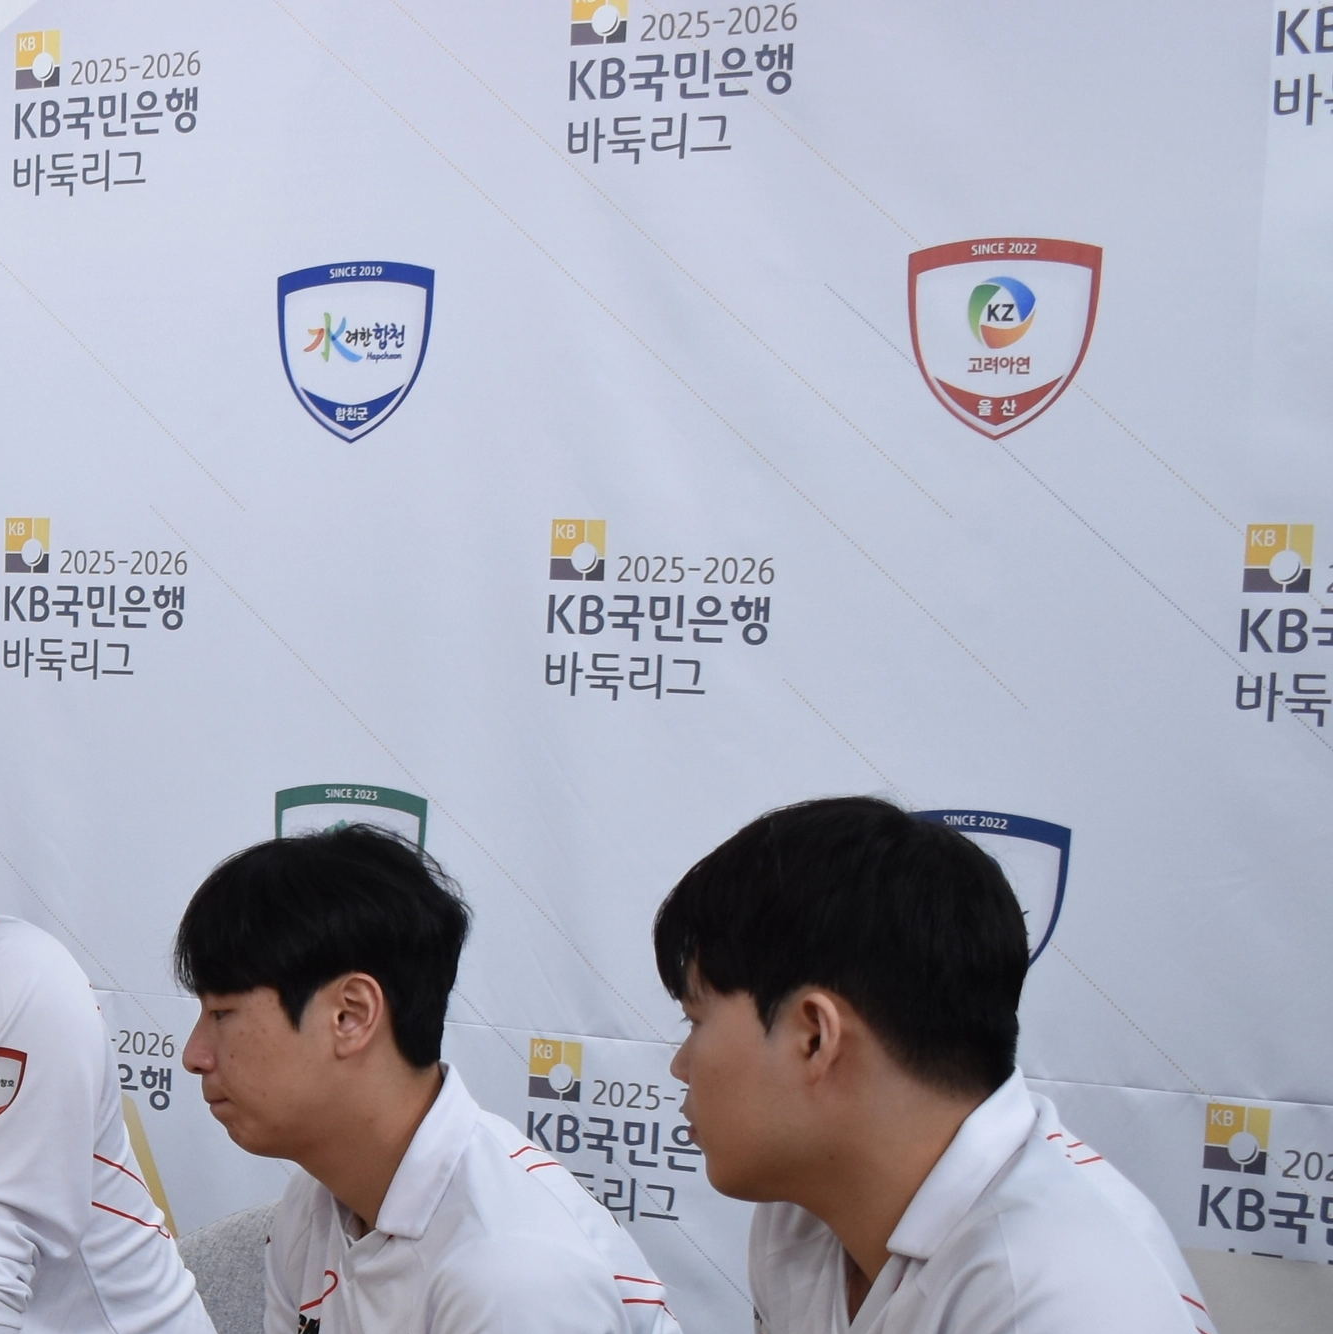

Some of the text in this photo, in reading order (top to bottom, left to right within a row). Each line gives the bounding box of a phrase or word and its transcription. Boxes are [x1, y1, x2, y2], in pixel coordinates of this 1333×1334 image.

[640, 2, 798, 42] 2025-2026
[18, 36, 36, 52] KB
[70, 50, 201, 86] 2025-2026
[568, 40, 794, 103] KB국민은행
[14, 84, 199, 141] KB국민은행
[567, 112, 732, 165] 바둑리그
[13, 149, 146, 197] 바둑리그
[971, 242, 1038, 256] SINCE 2022
[329, 265, 383, 279] SINCE 2019
[986, 302, 1015, 324] KZ
[366, 348, 402, 364] Hapcheon
[967, 356, 1031, 375] 고려아연
[335, 405, 369, 423] 합천군
[976, 398, 1018, 416] 울산
[5, 518, 26, 536] KB
[555, 523, 577, 540] KB
[1251, 529, 1276, 547] KB
[59, 549, 188, 576] 2025-2026
[617, 555, 775, 585] 2025-2026
[4, 584, 185, 631] KB국민은행
[546, 594, 771, 646] KB국민은행
[3, 637, 134, 682] 바둑리그
[545, 651, 706, 702] 바둑리그
[325, 785, 381, 801] SINCE 2023
[942, 814, 1008, 830] SINCE 2022
[533, 1043, 553, 1060] KB
[1210, 1109, 1234, 1127] KB
